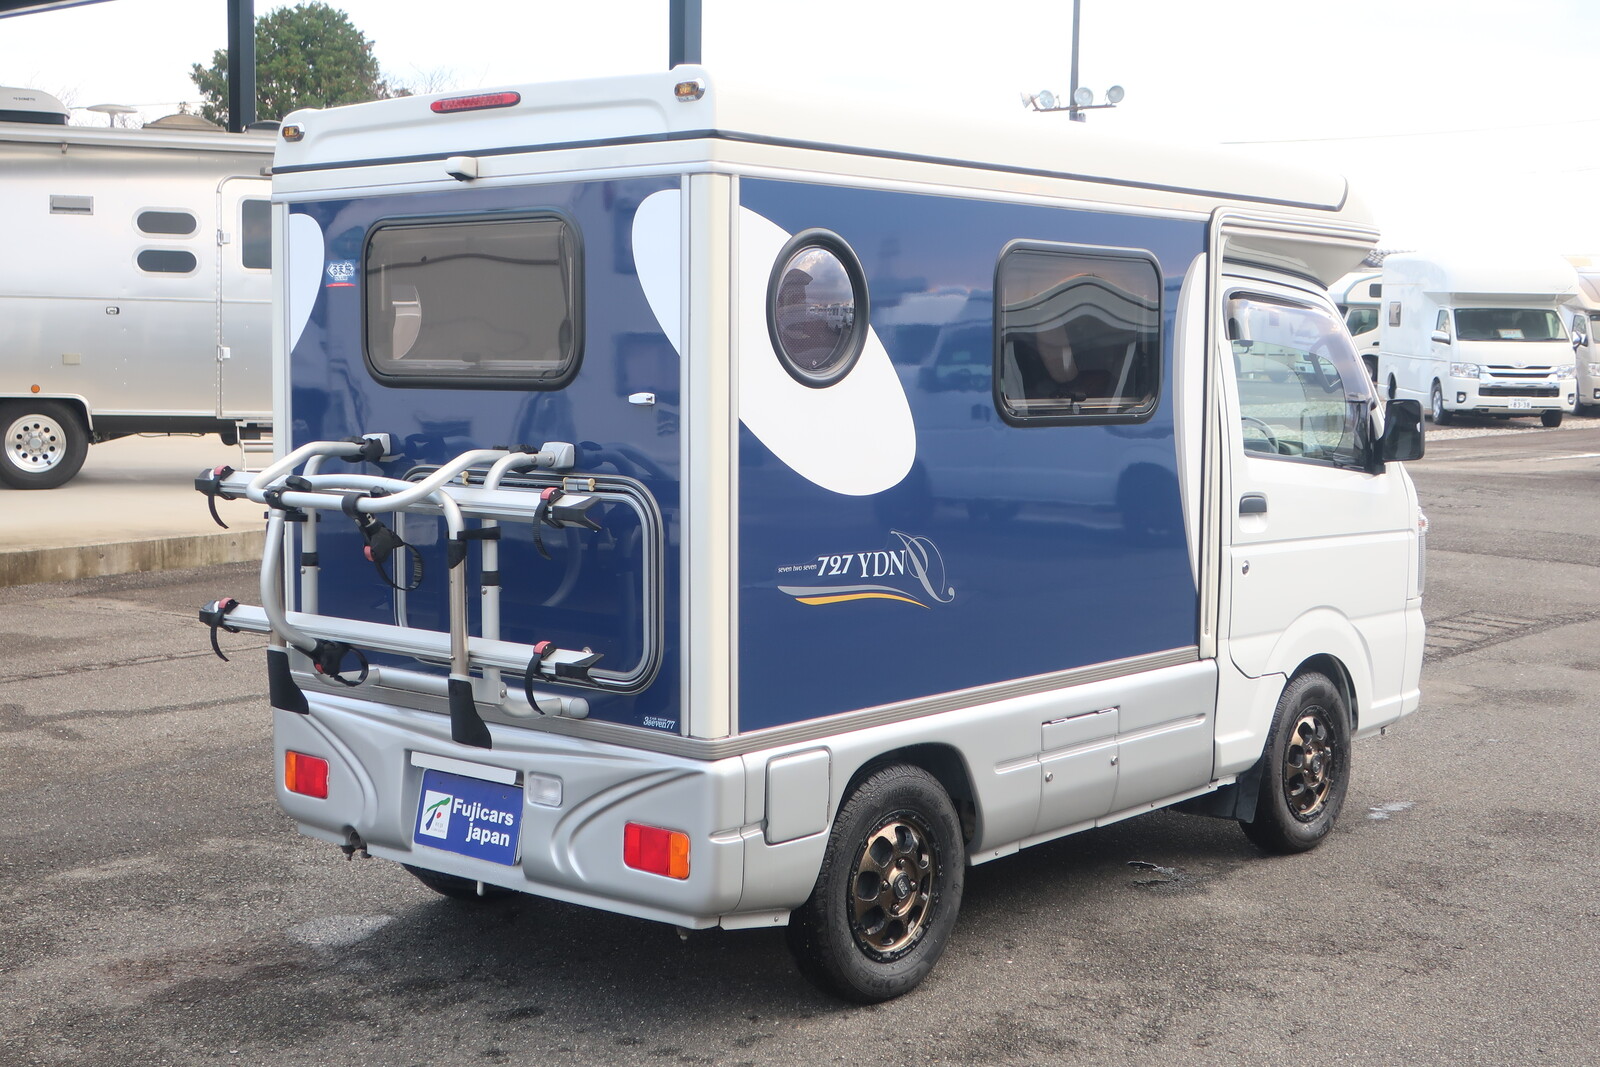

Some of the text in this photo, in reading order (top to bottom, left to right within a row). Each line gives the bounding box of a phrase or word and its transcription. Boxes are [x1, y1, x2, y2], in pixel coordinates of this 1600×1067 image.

[817, 555, 853, 577] 727
[857, 550, 905, 578] YDN
[643, 716, 675, 729] 3seven77
[452, 798, 514, 826] Fujicars
[465, 822, 510, 847] japan
